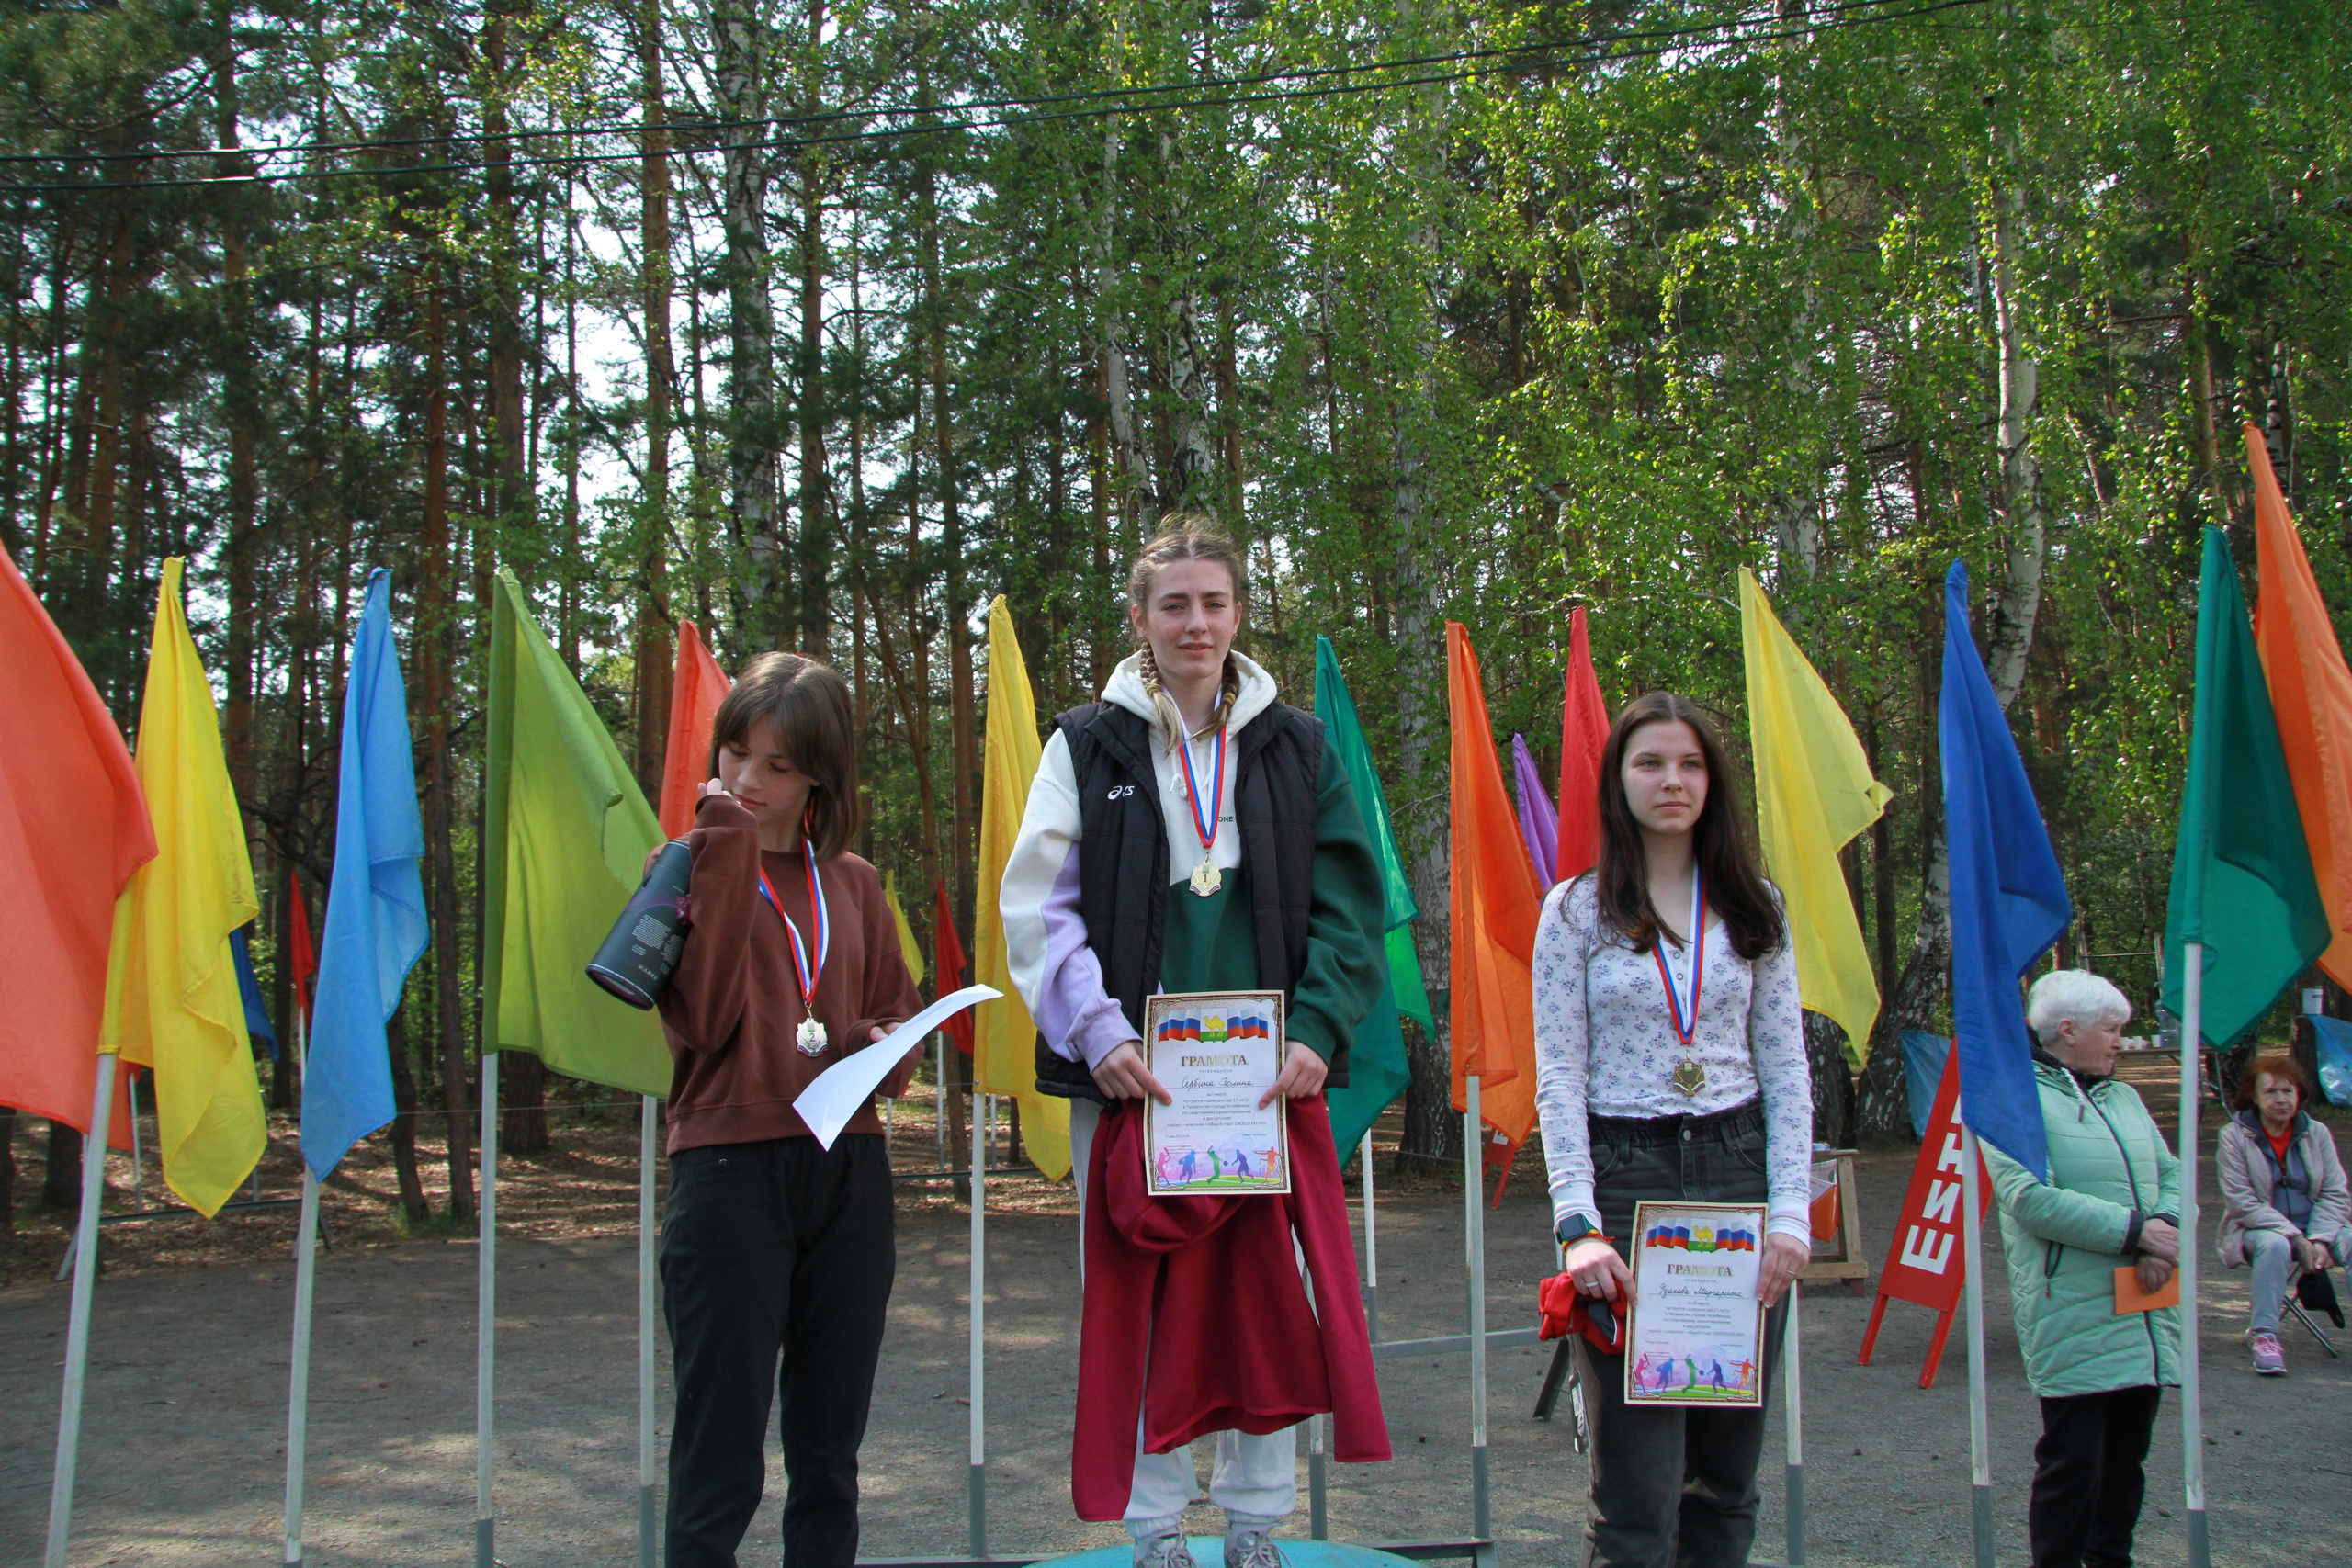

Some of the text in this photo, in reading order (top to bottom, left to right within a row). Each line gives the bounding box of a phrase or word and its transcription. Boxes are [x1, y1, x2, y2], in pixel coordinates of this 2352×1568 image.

[1203, 874, 1208, 883] 1
[808, 1032, 816, 1043] 2
[1181, 1055, 1248, 1066] ГРАМОТА
[1899, 1093, 1963, 1275] НИШ
[1667, 1263, 1733, 1277] ГРАМОТА
